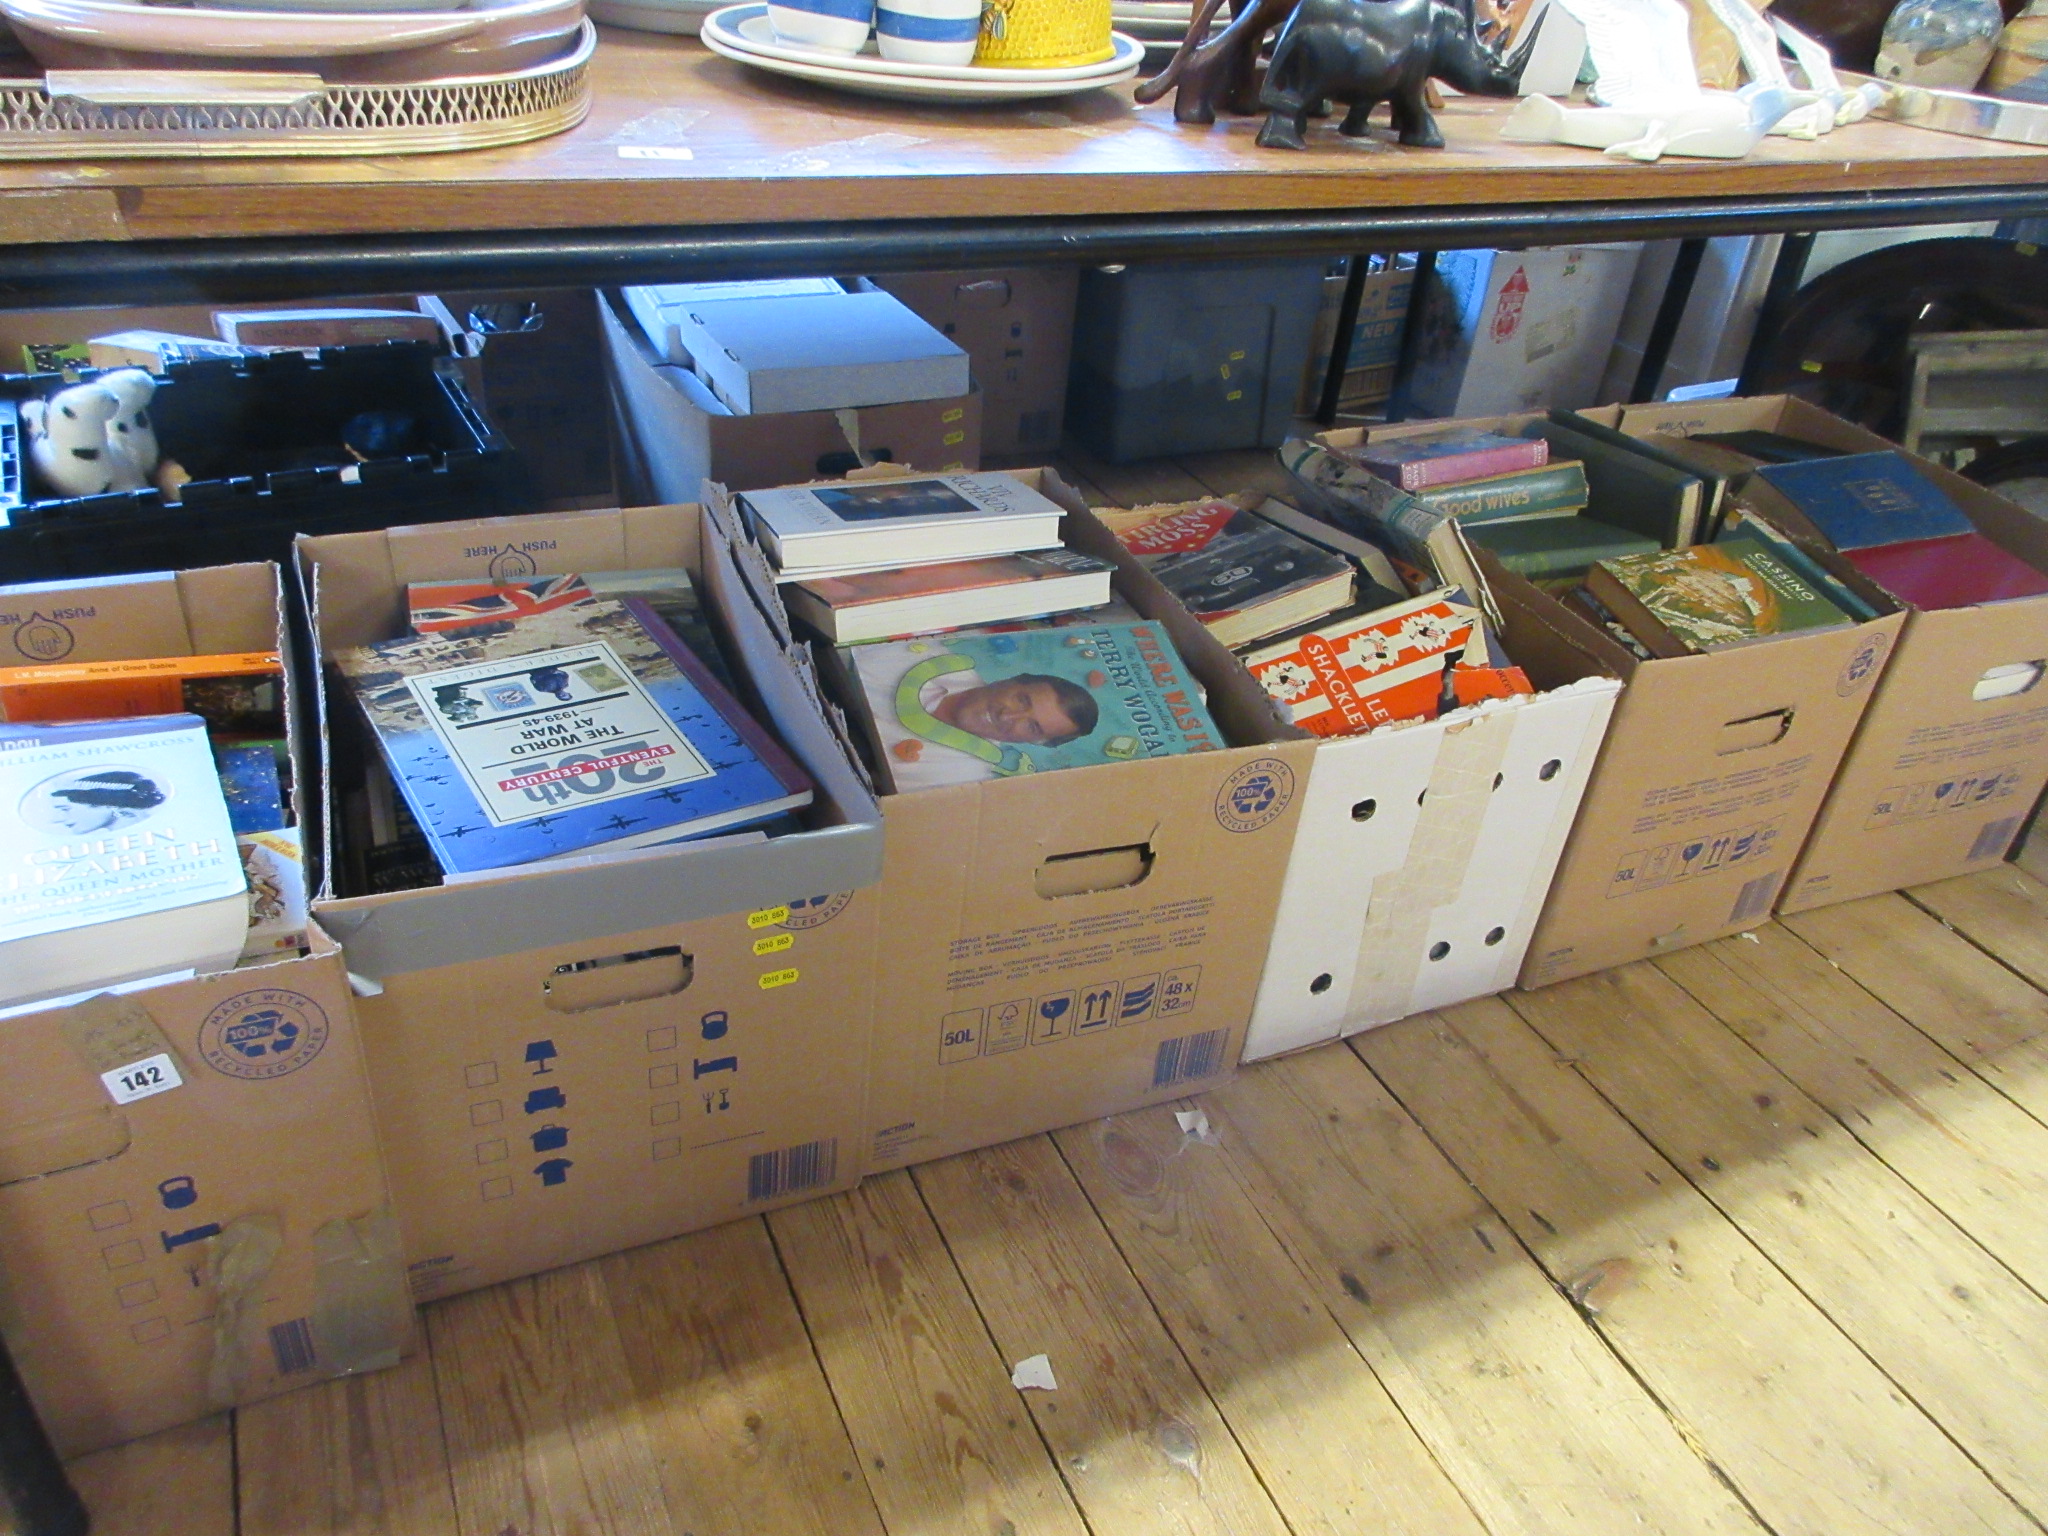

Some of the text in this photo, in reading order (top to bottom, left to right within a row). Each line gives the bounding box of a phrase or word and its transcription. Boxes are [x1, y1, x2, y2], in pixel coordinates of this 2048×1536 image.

[1116, 507, 1218, 544] TIRLING
[1138, 523, 1210, 548] MOSS
[464, 540, 557, 558] PUSH HERE
[1754, 553, 1815, 600] CASSINO
[54, 606, 96, 620] PUSH
[88, 666, 110, 674] Anne
[122, 663, 147, 672] Green
[149, 661, 177, 670] Gables
[1091, 628, 1137, 690] TERRY
[1131, 626, 1179, 688] WHERE
[1162, 690, 1204, 731] WAS
[1307, 644, 1370, 735] SHACKLET
[1496, 669, 1516, 694] occer
[522, 710, 580, 727] 1939-45
[1366, 699, 1391, 722] LE
[511, 725, 624, 755] THE WORLD
[520, 717, 594, 739] AT WAR
[0, 736, 195, 768] ILLIAM SHAWCROSS
[643, 758, 663, 767] THE
[504, 746, 671, 791] EVENTFUL CENTURY
[511, 740, 666, 805] 20th
[1230, 762, 1288, 784] MADE WITH
[1236, 786, 1260, 798] 100%
[1219, 794, 1288, 829] RECYCLED PAPER
[24, 828, 175, 866] QUEEN
[6, 838, 222, 892] LIZABETH
[42, 877, 119, 897] QUEEN
[130, 857, 224, 882] MOTHER
[786, 893, 849, 927] CLED PAPE
[1165, 982, 1184, 995] 48
[210, 993, 305, 1025] MADE WITH
[229, 1025, 271, 1040] 100%
[944, 1030, 976, 1047] 50L
[208, 1027, 323, 1075] RECYCLED PAPER
[121, 1066, 165, 1091] 142
